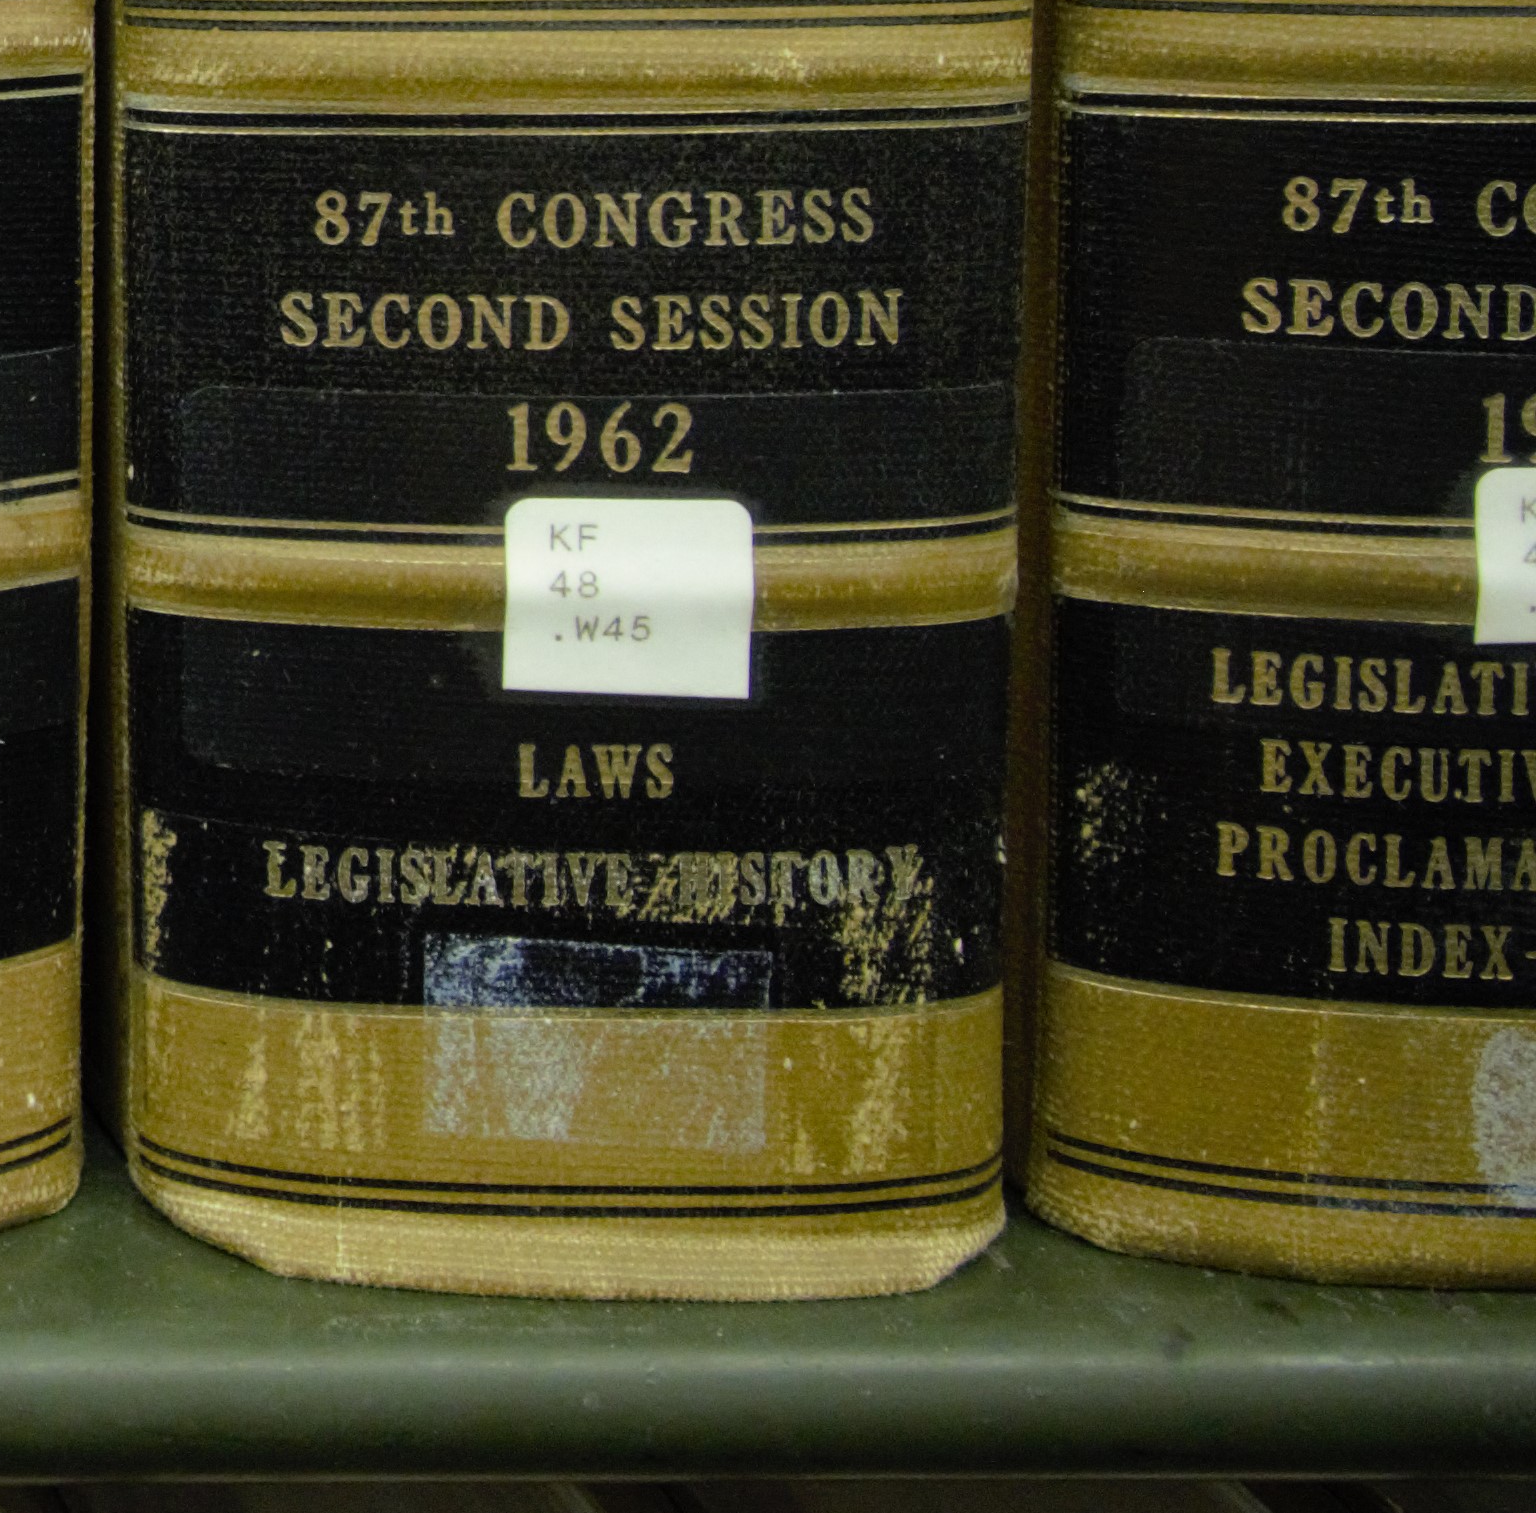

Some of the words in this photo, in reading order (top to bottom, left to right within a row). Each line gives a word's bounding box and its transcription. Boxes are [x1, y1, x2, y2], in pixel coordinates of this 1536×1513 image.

[314, 190, 455, 246] 87th
[497, 187, 875, 249] CONGRESS
[1282, 176, 1434, 235] 87th
[280, 291, 571, 351] SECOND
[610, 289, 903, 352] SESSION
[1242, 276, 1536, 341] SECOND
[506, 400, 694, 474] 1962
[549, 524, 598, 552] KF
[549, 571, 599, 600] 48
[554, 616, 652, 644] .W45
[518, 743, 675, 799] LAWS
[263, 841, 631, 908] LEGISLATIVE
[676, 844, 924, 906] HISTORY
